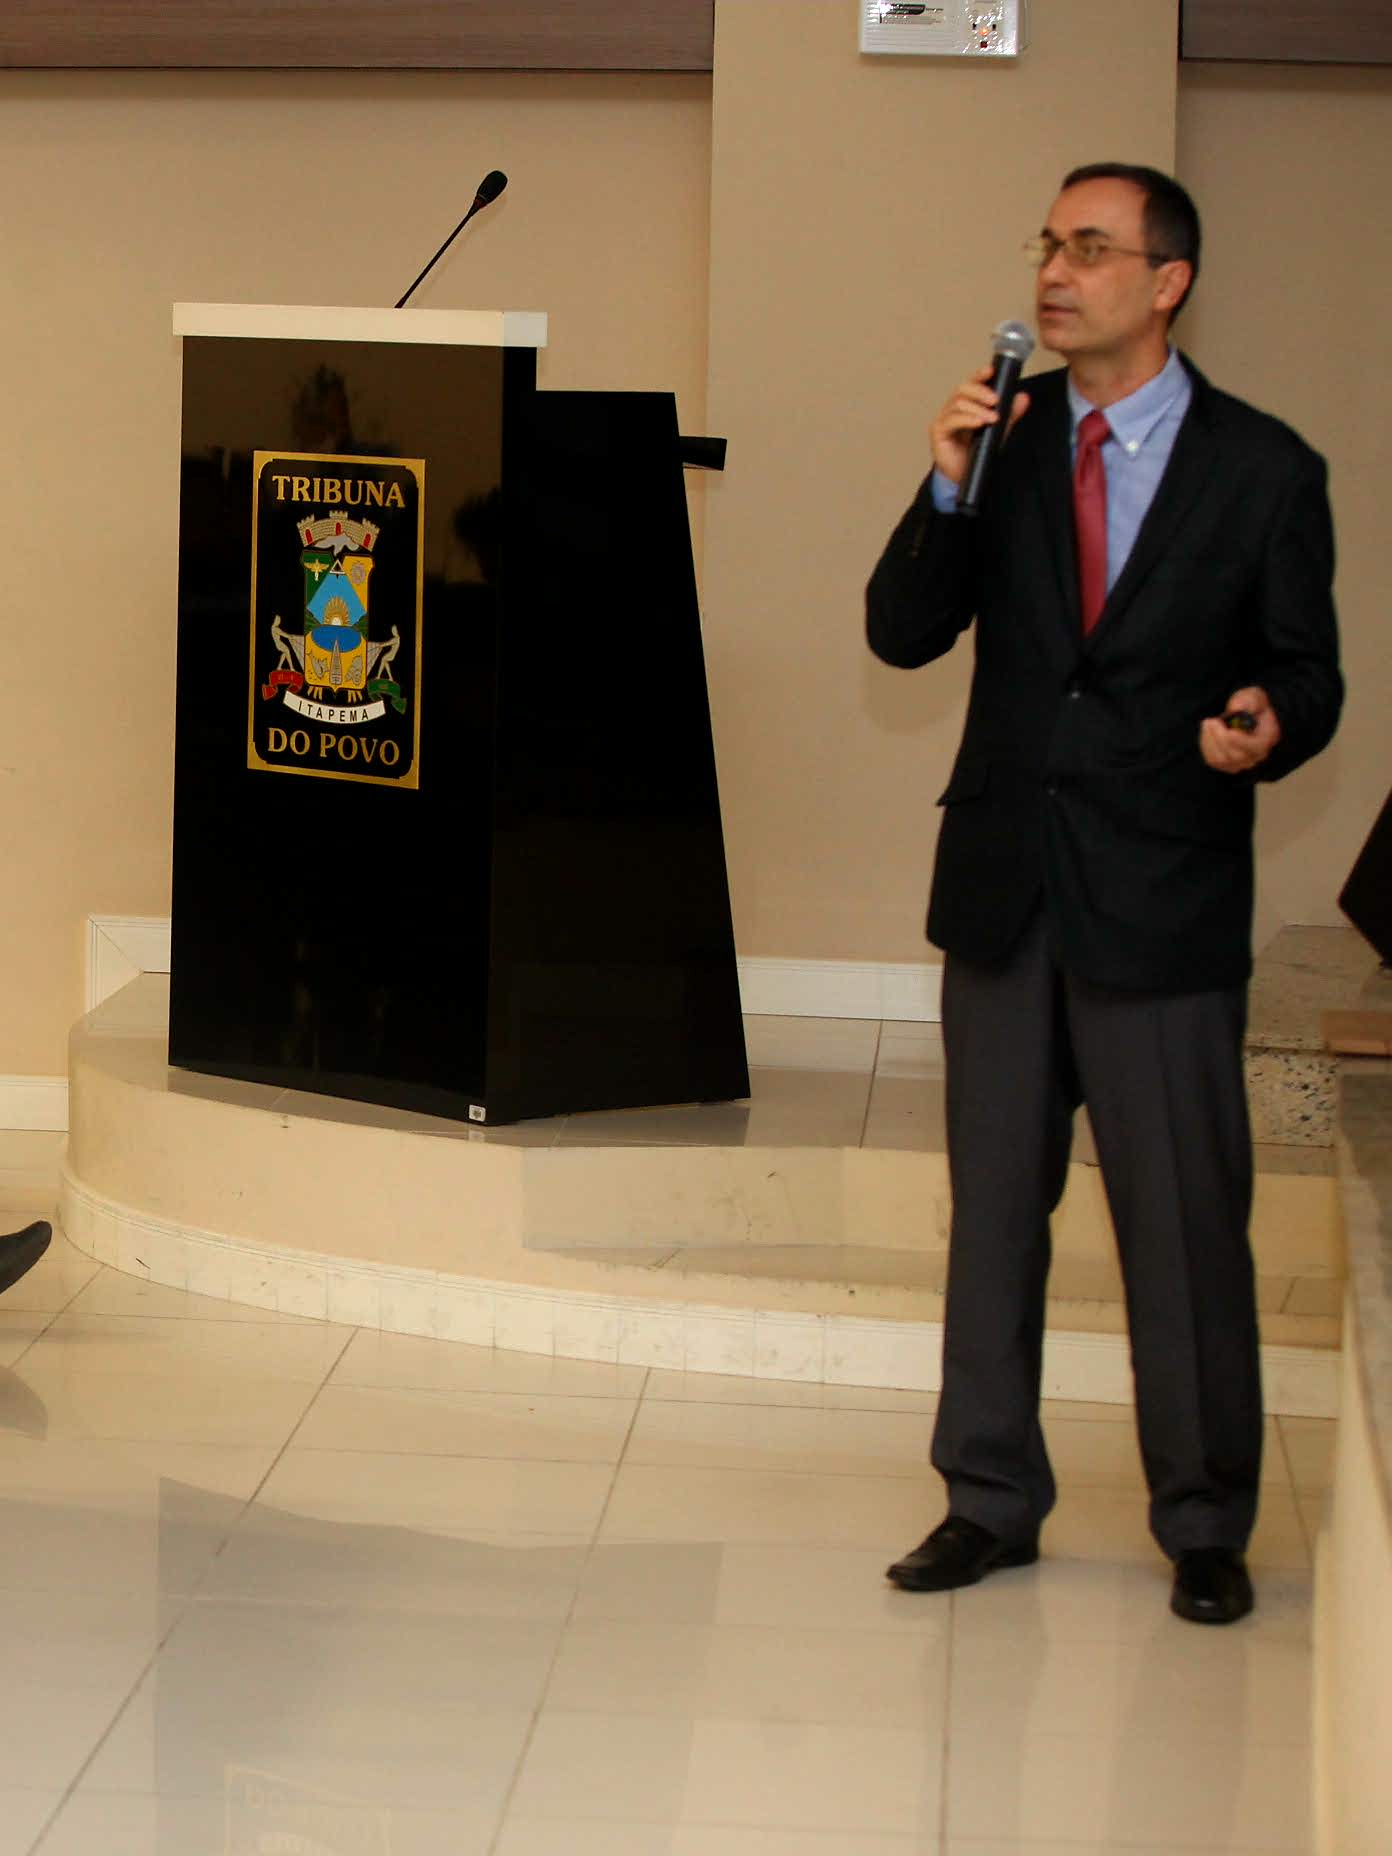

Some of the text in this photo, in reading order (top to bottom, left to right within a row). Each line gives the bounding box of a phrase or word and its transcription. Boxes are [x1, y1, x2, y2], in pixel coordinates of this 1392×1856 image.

[272, 475, 406, 508] TRIBUNA
[298, 700, 369, 722] ITAPEMA
[267, 727, 400, 766] DO POVO
